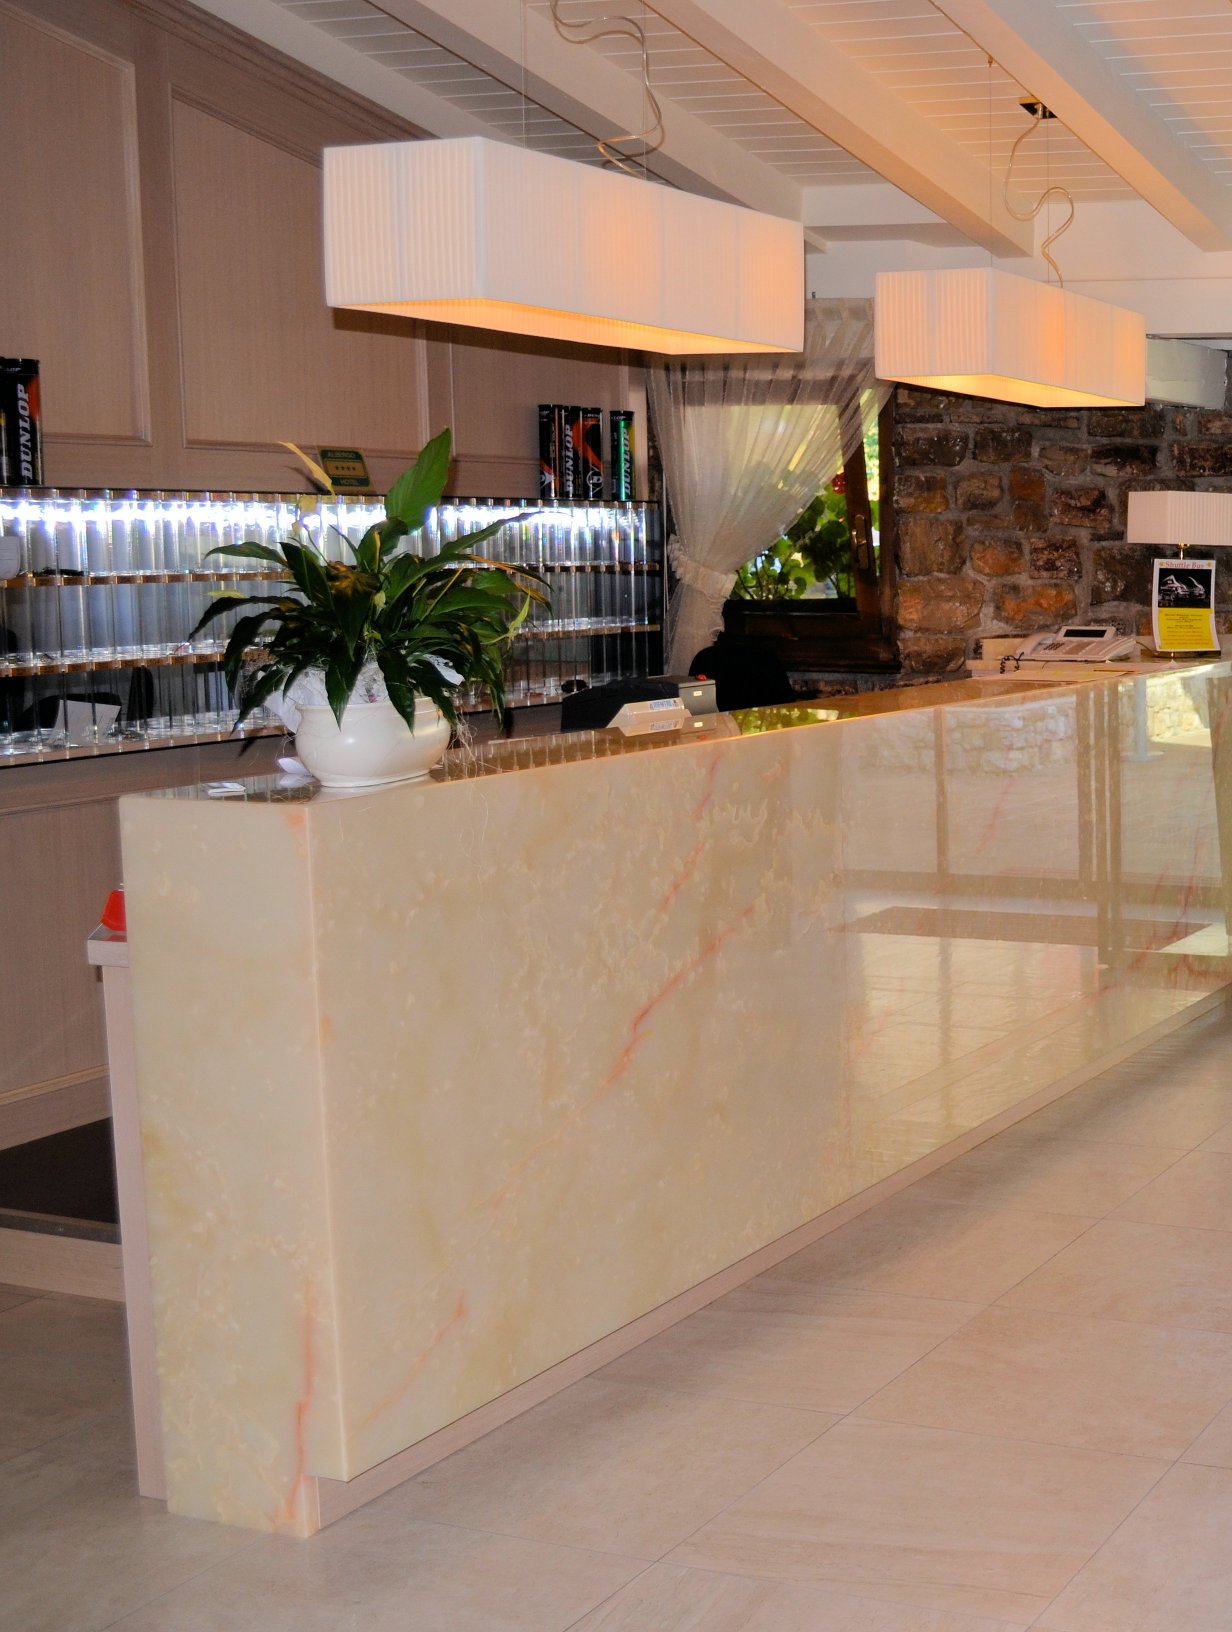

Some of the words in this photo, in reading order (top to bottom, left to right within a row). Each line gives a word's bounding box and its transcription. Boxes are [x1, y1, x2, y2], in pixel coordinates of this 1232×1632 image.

[17, 383, 33, 480] DUNLOP
[565, 423, 574, 495] DUNLOP
[623, 427, 631, 495] DUNLOP
[1165, 560, 1190, 569] Shuttle
